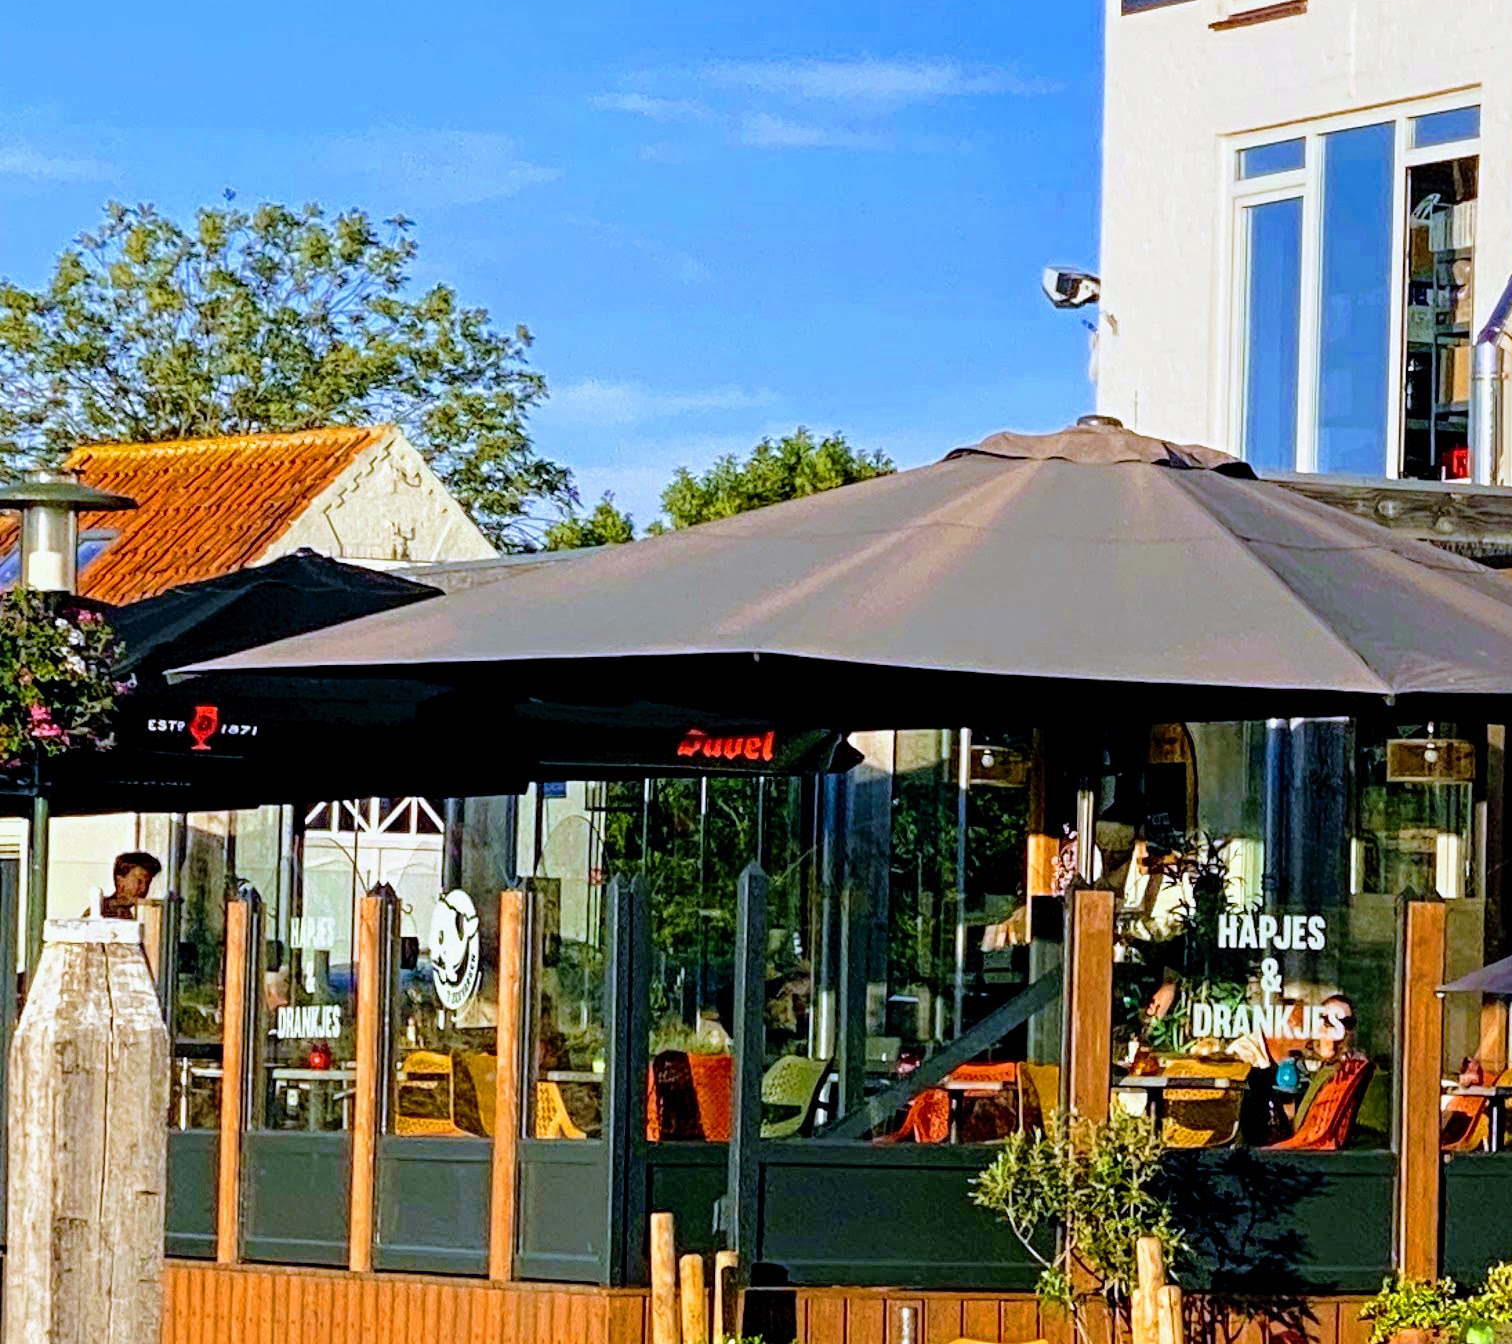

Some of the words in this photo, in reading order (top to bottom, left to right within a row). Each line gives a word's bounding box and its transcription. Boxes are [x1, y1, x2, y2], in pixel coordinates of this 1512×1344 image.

[221, 724, 258, 736] 1871
[290, 916, 335, 949] HAPJES
[1218, 914, 1326, 950] HAPJES
[1260, 957, 1282, 992] &
[277, 1005, 341, 1039] DRANKJES
[1192, 1003, 1346, 1041] DRANKJES
